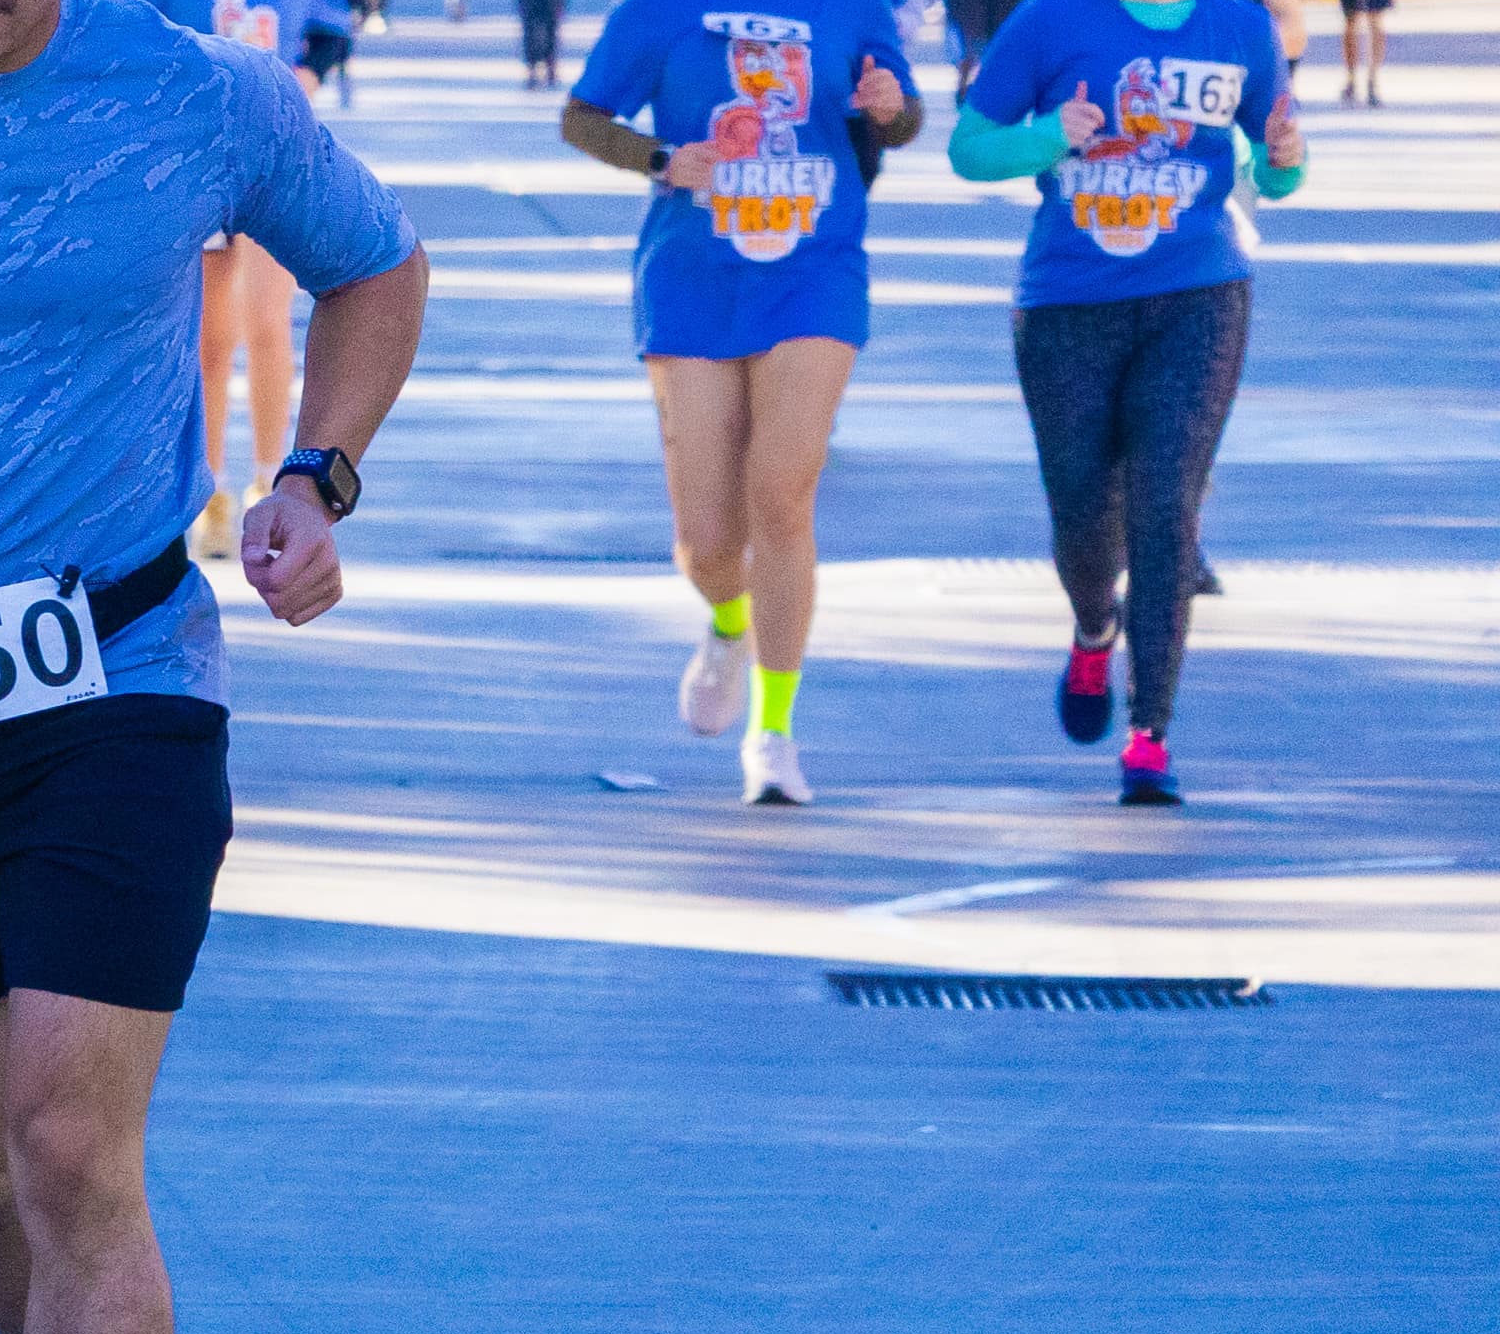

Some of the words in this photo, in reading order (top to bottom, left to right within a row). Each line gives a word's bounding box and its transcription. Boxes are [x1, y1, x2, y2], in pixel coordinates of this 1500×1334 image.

[694, 159, 841, 207] URKEY
[1056, 161, 1207, 209] TURKEY
[711, 194, 817, 234] TROT
[1072, 191, 1178, 231] TROT
